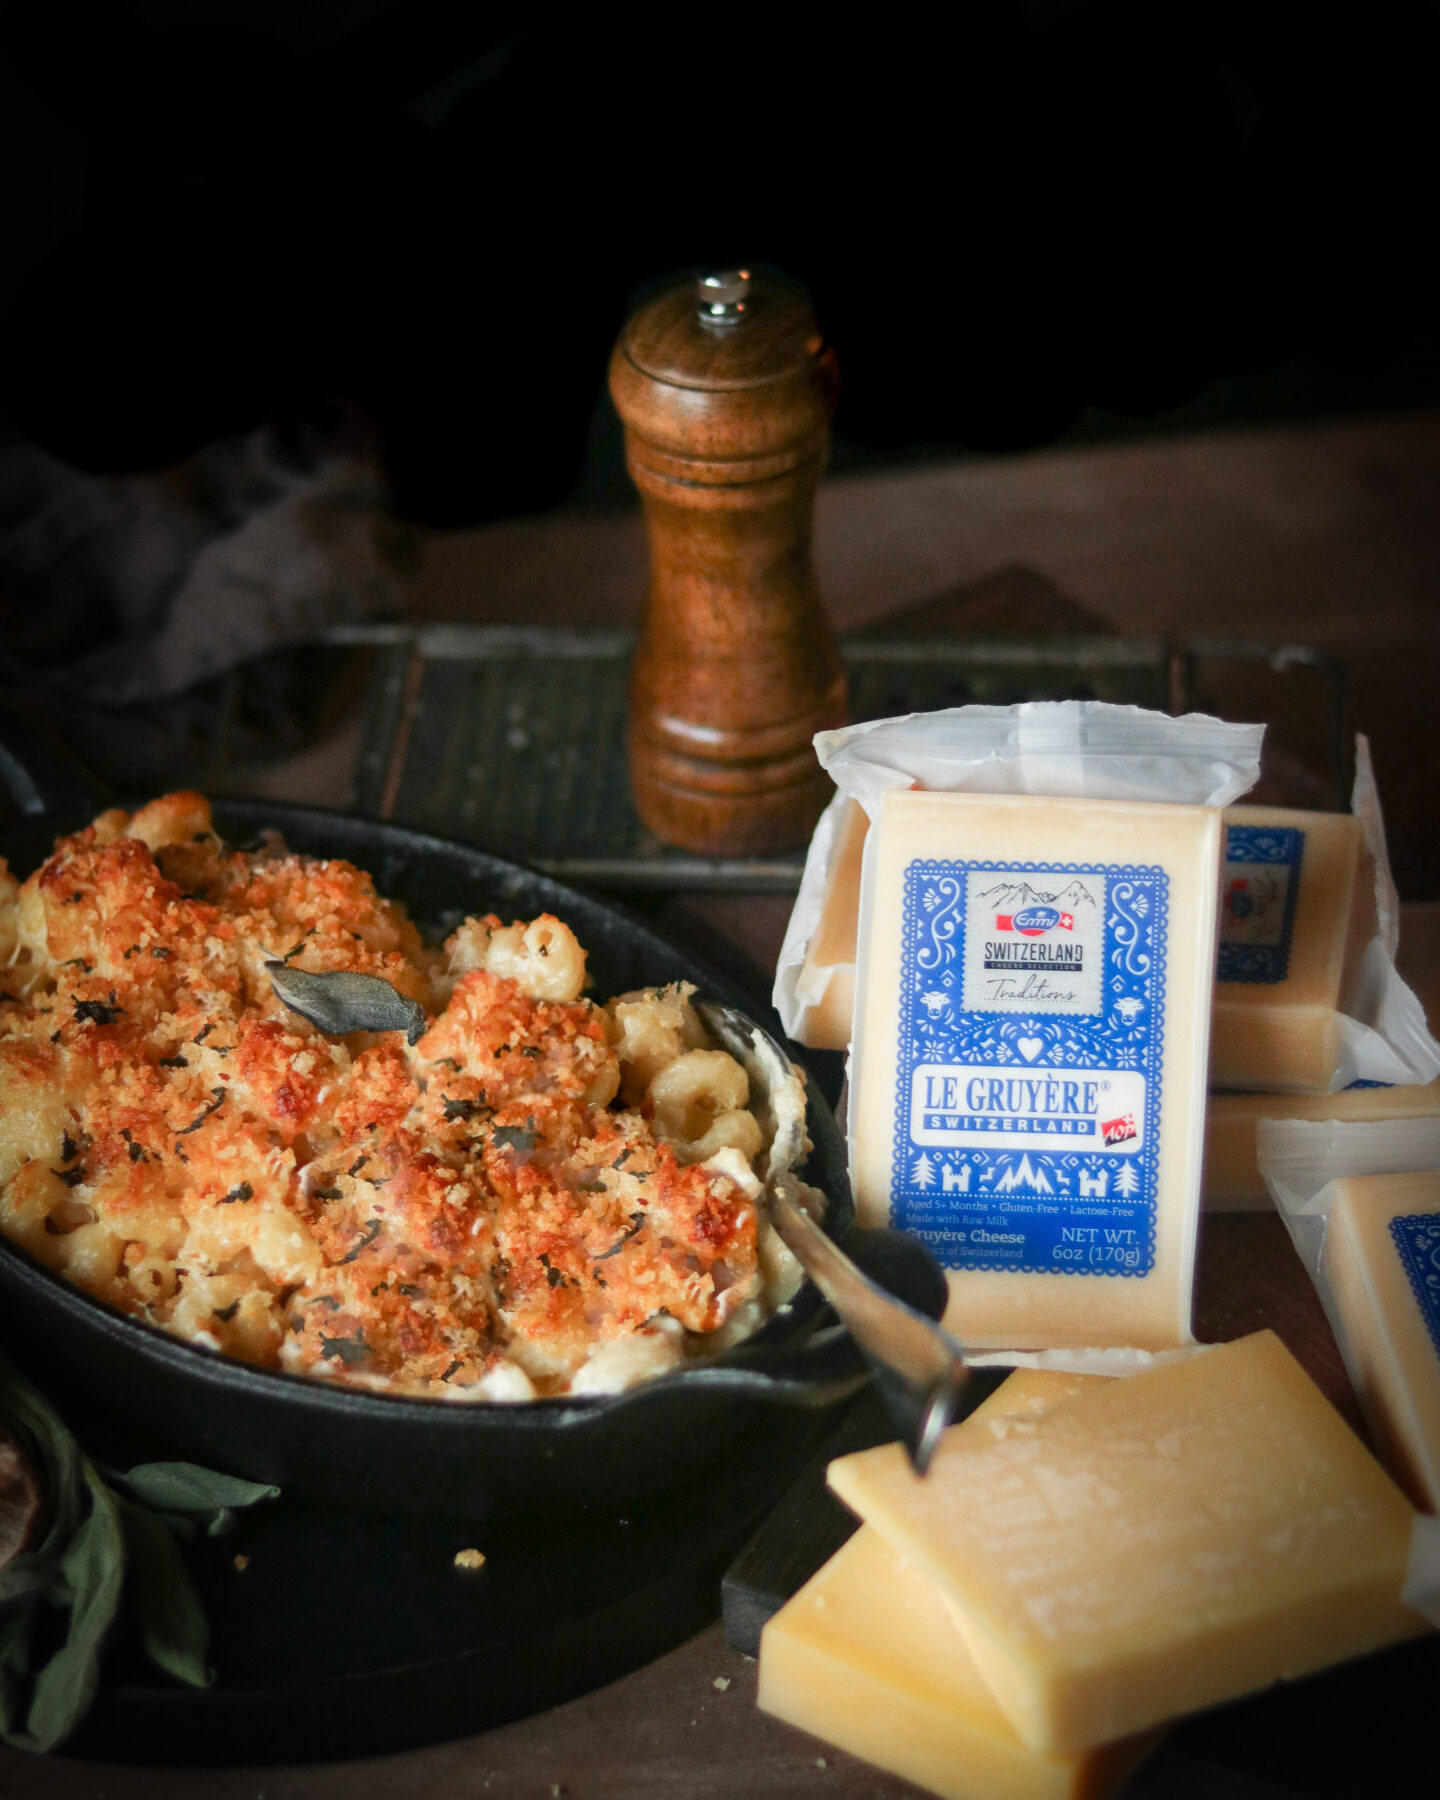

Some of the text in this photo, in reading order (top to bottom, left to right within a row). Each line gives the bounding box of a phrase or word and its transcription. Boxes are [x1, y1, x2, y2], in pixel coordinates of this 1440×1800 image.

[1016, 912, 1057, 927] Emmi
[984, 942, 1083, 962] SWITZERLAND
[990, 962, 1077, 971] CHEESE SELECTION
[986, 973, 1078, 1001] Traditions
[924, 1076, 957, 1110] LE
[930, 1116, 1090, 1133] SWITZERLAND
[1104, 1124, 1135, 1141] AOP
[906, 1199, 933, 1210] Aged
[949, 1201, 989, 1211] Months
[999, 1202, 1060, 1214] Gluten-Free
[1070, 1205, 1135, 1217] Lactose-Free
[905, 1213, 1009, 1226] Made with Raw Milk
[970, 1228, 1026, 1244] Cheese
[1061, 1227, 1140, 1245] NET WT.
[947, 1245, 959, 1255] of
[960, 1246, 1024, 1258] Switzerland
[1052, 1244, 1141, 1267] 6oz (170g)
